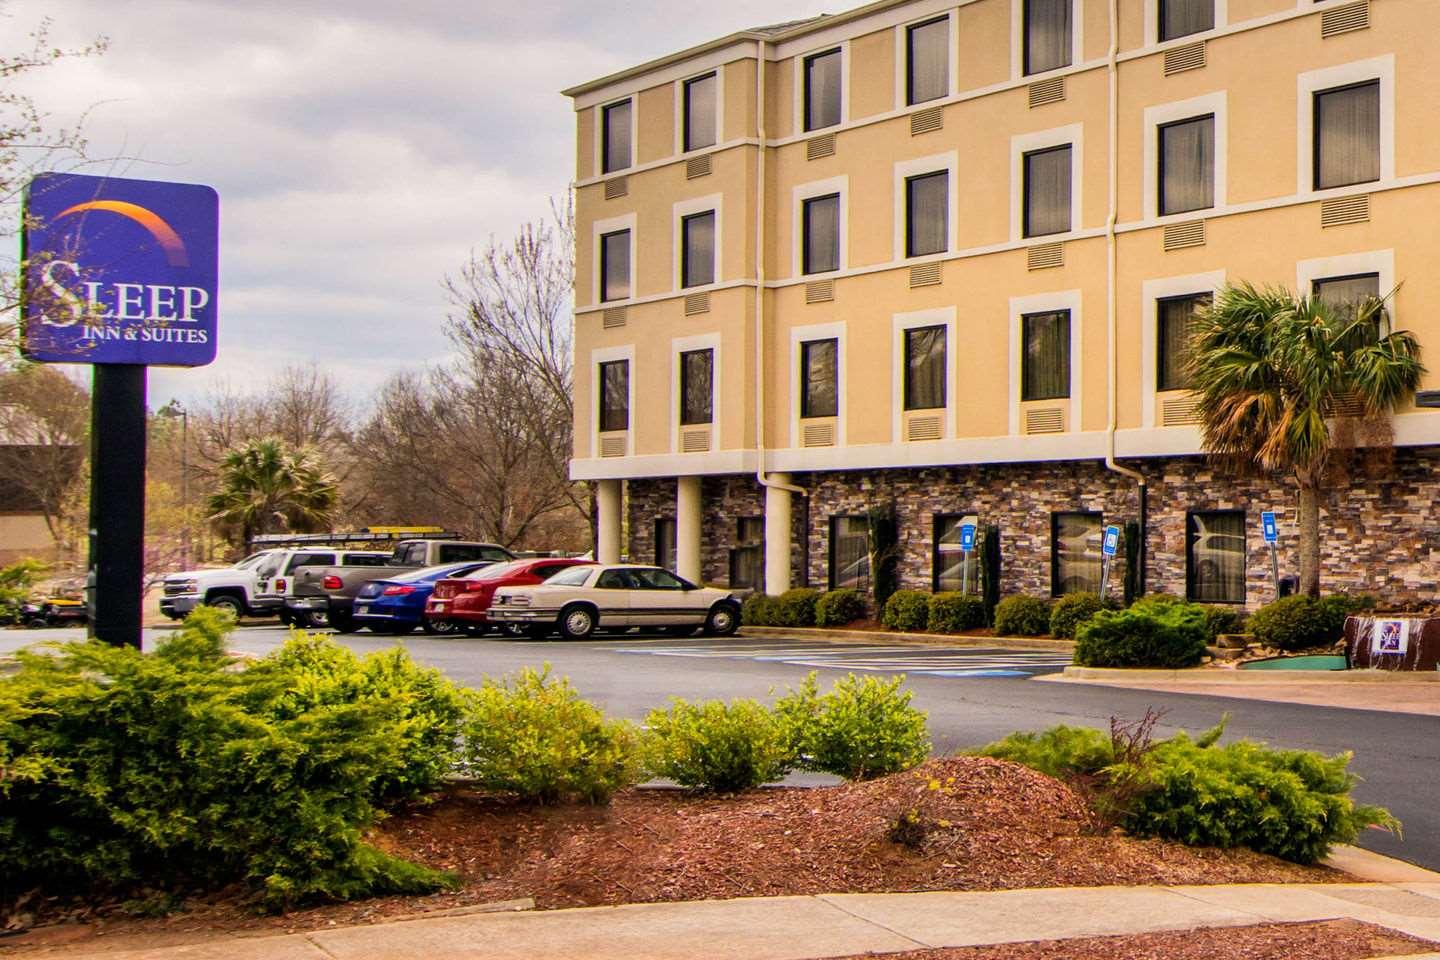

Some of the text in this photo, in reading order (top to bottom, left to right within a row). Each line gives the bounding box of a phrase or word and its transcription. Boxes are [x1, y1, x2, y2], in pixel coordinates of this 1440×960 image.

[40, 260, 209, 327] SLEEP
[83, 325, 208, 344] INN & SUITES
